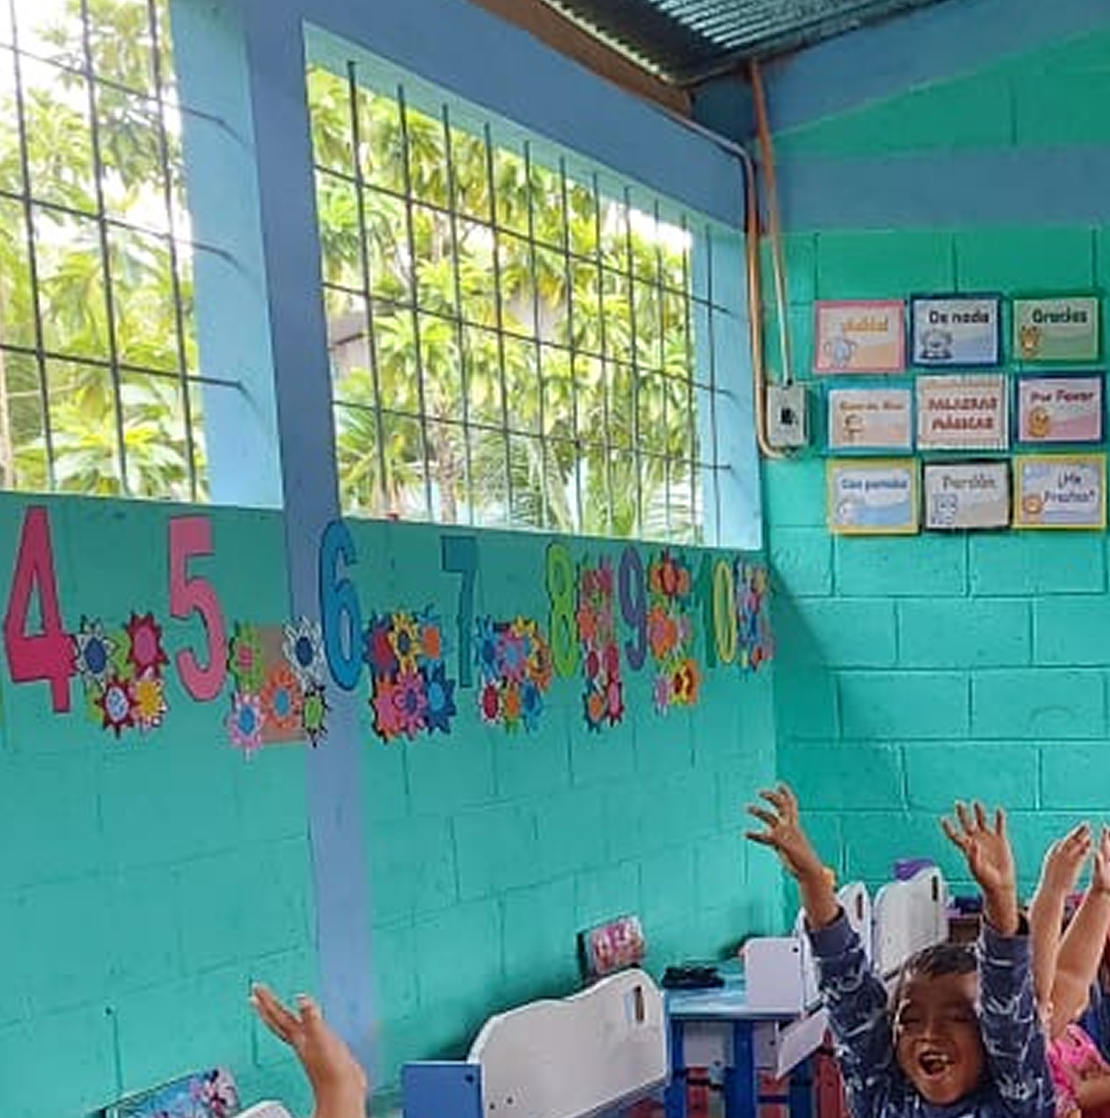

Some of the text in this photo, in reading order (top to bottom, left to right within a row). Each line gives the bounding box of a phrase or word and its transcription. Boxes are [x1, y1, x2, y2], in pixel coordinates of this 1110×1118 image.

[929, 309, 990, 324] De nada
[1032, 307, 1088, 324] Gracias
[5, 506, 74, 713] 4
[168, 516, 226, 701] 5
[320, 521, 362, 690] 6
[441, 535, 481, 688] 7
[545, 543, 579, 677] 8
[618, 546, 647, 670] 9
